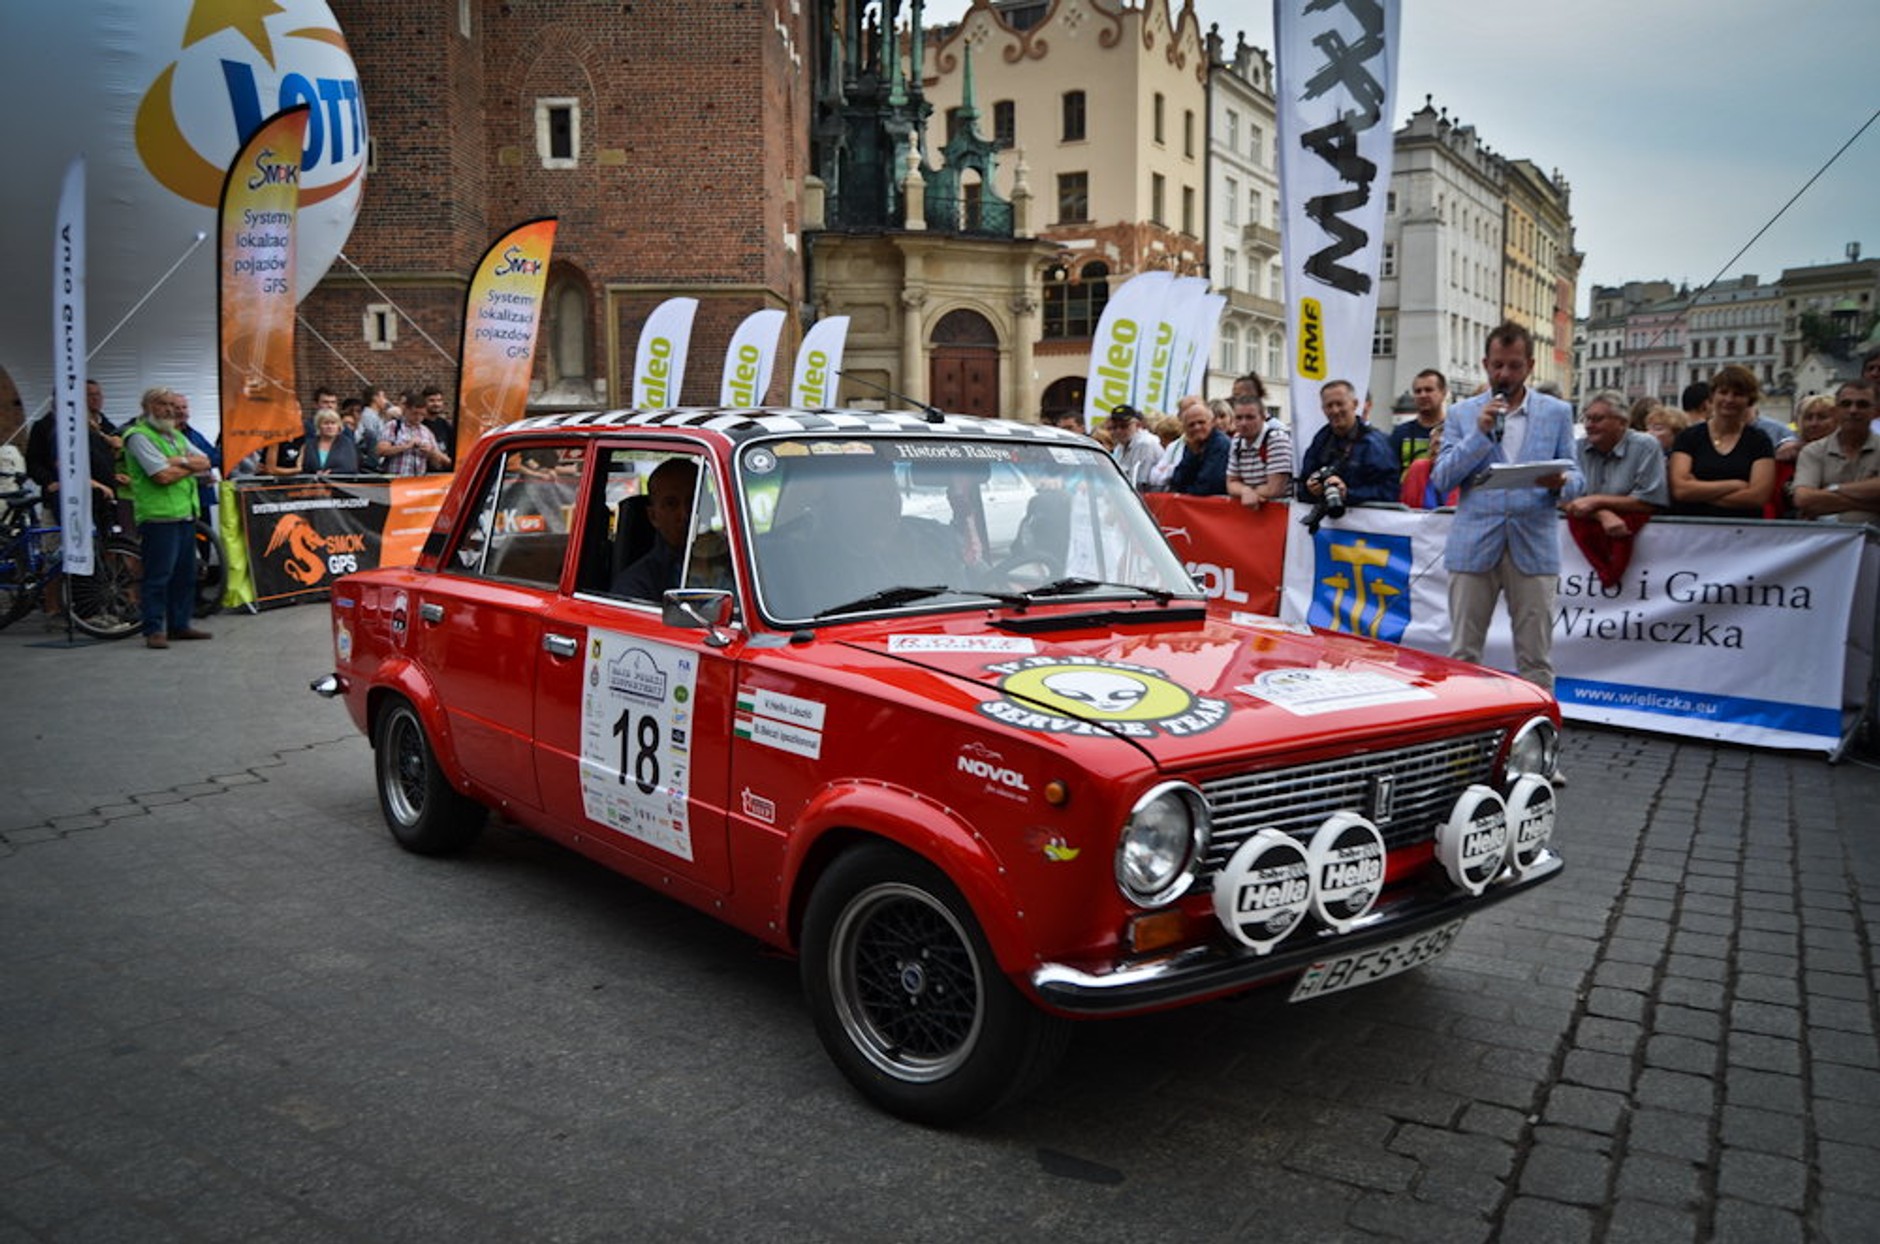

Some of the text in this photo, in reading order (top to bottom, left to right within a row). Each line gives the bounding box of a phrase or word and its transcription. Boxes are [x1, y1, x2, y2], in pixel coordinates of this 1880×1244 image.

[220, 59, 366, 173] LOTT
[263, 278, 288, 293] GPS
[506, 346, 530, 359] GPS
[1303, 303, 1320, 373] RMF
[640, 337, 671, 409] aleo
[728, 344, 759, 409] aleo
[799, 351, 828, 408] aleo
[896, 444, 961, 458] Historic
[326, 534, 366, 554] SMOK
[328, 554, 358, 574] GPS
[1639, 570, 1649, 600] i
[1665, 571, 1812, 610] Gmina
[1551, 604, 1744, 649] Wieliczka
[980, 698, 1226, 737] SERVICE TEAM
[1574, 686, 1717, 714] www.wieliczka.eu
[613, 708, 660, 795] 18
[957, 755, 1030, 791] NOVOL
[1465, 827, 1506, 858] Hella
[1323, 858, 1381, 889] Hella
[1240, 879, 1308, 911] Hella
